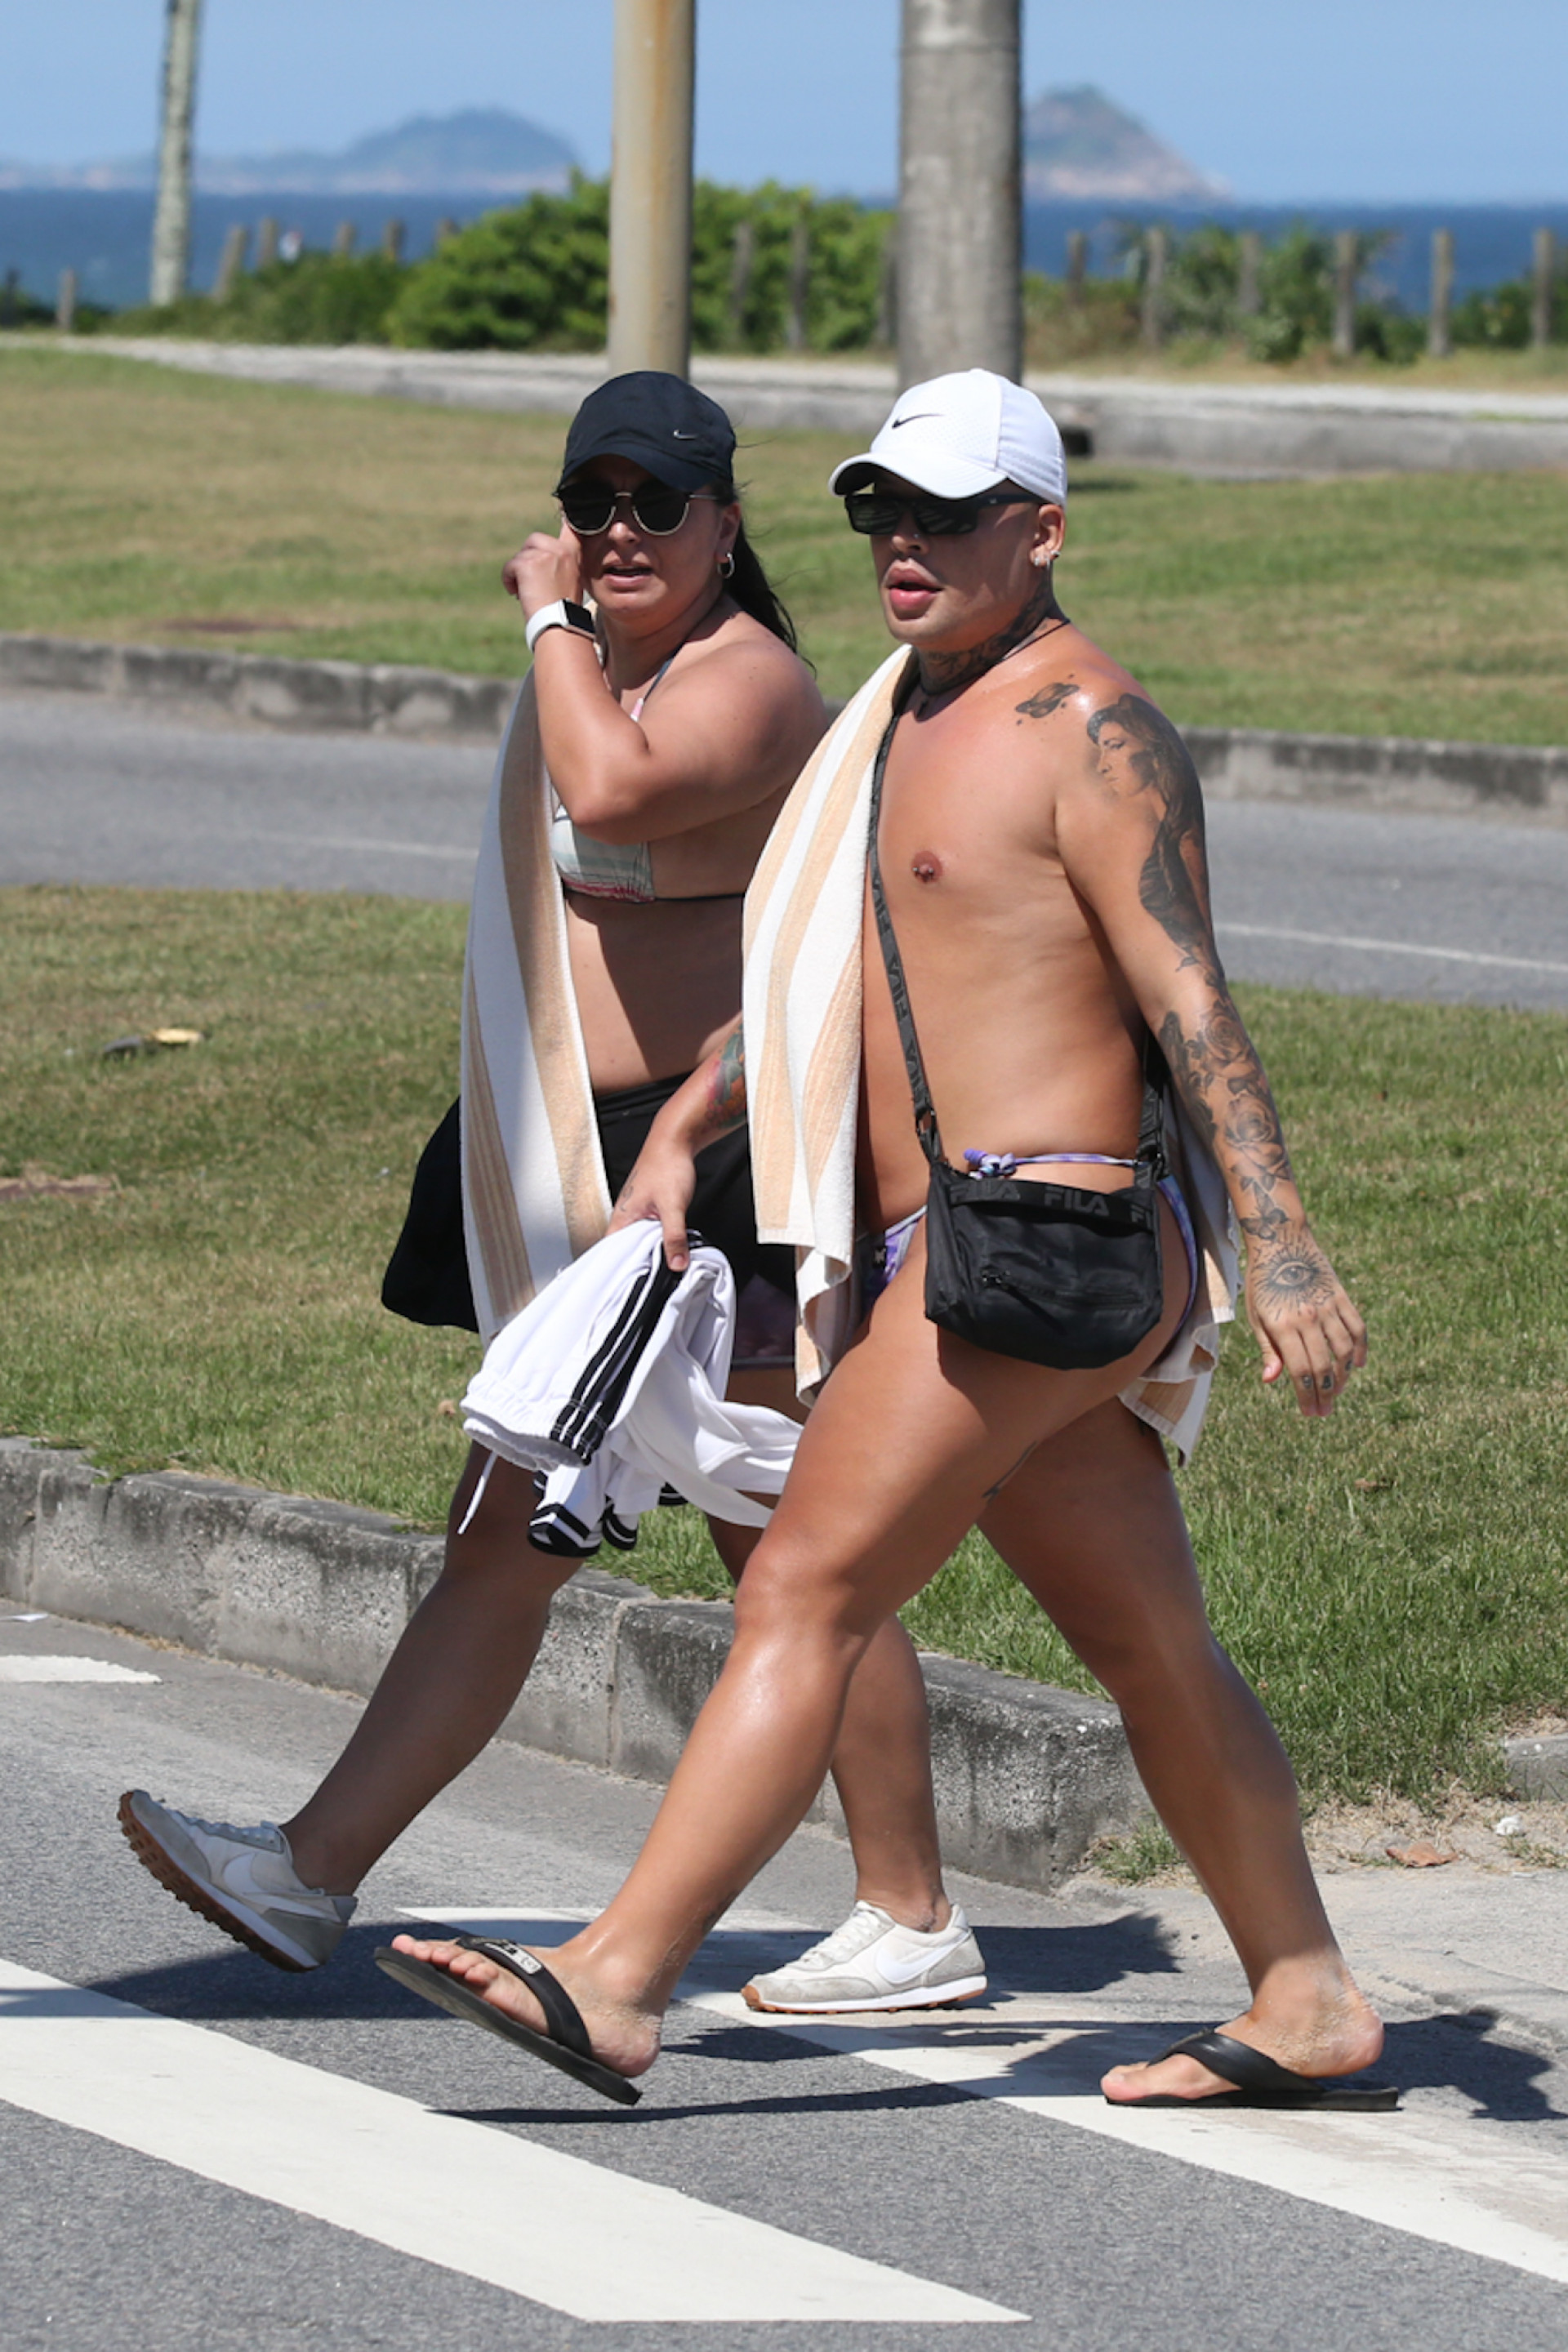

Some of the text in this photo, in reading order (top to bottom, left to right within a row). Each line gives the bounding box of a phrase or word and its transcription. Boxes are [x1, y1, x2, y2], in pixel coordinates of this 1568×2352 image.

[888, 953, 908, 1018] FILA
[951, 1181, 1152, 1228] FILA FILA FI
